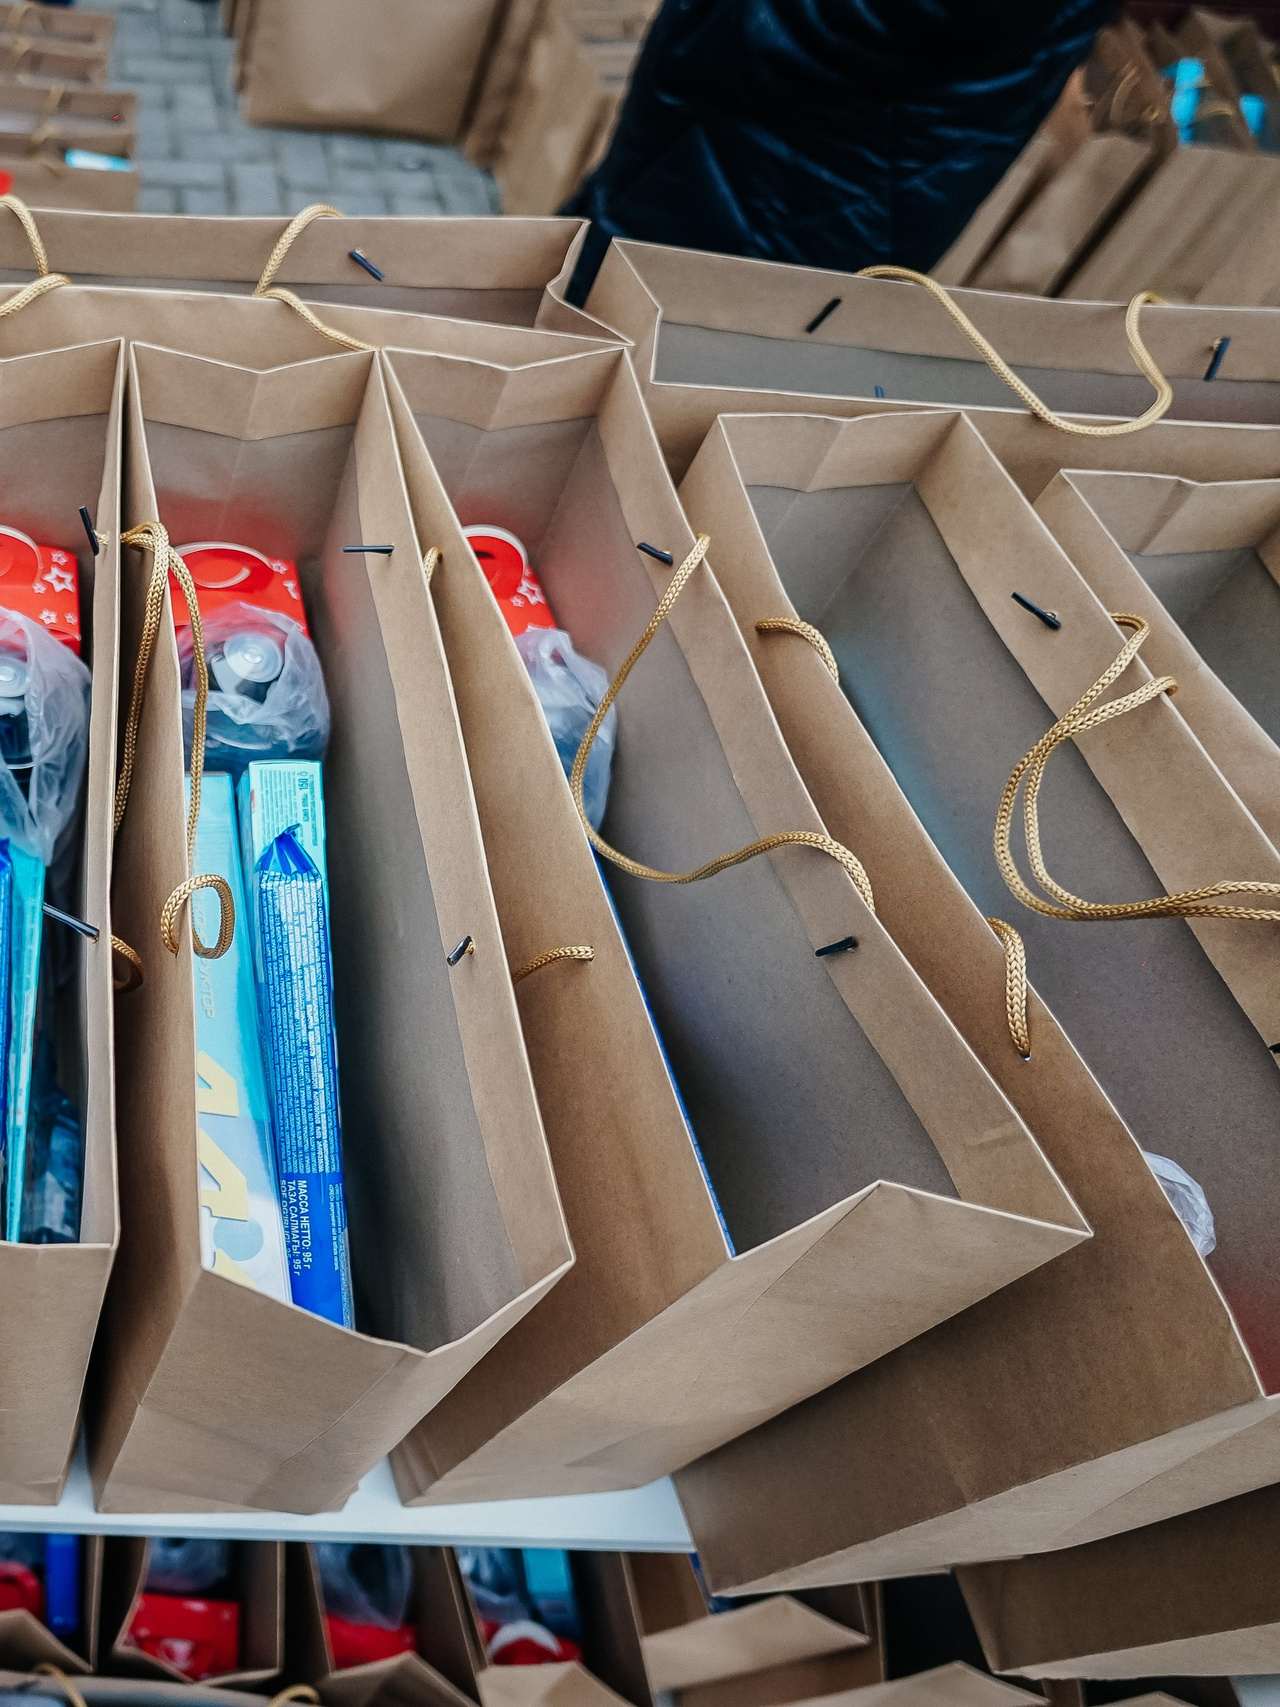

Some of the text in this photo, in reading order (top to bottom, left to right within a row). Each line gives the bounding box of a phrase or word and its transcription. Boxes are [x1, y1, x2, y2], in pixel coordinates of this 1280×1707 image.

[297, 778, 308, 790] 150
[287, 1180, 297, 1204] ТАЗА
[297, 1180, 308, 1214] МАССА
[289, 1206, 300, 1256] САЛМАҒЫ:
[300, 1216, 310, 1249] НЕТТО:
[293, 1259, 301, 1269] 95
[302, 1252, 312, 1262] 95
